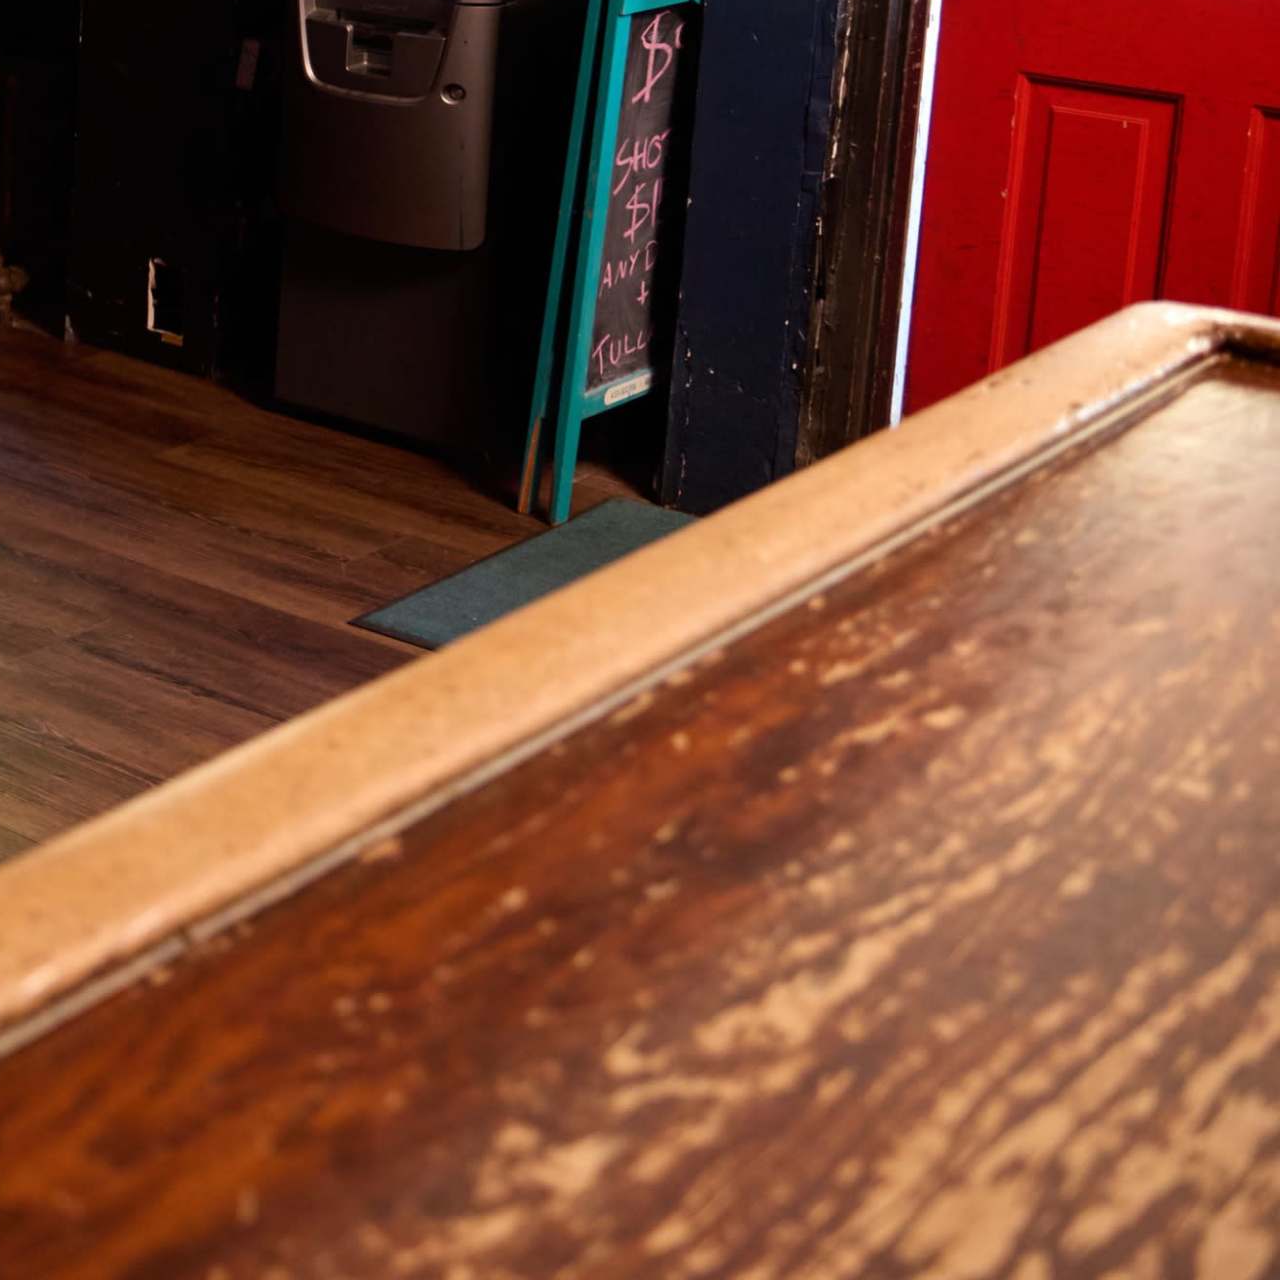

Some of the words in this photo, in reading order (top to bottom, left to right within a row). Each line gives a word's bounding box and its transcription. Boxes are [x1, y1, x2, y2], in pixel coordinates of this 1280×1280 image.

[613, 128, 672, 196] SHO
[624, 178, 663, 243] $1
[592, 330, 648, 375] TULL
